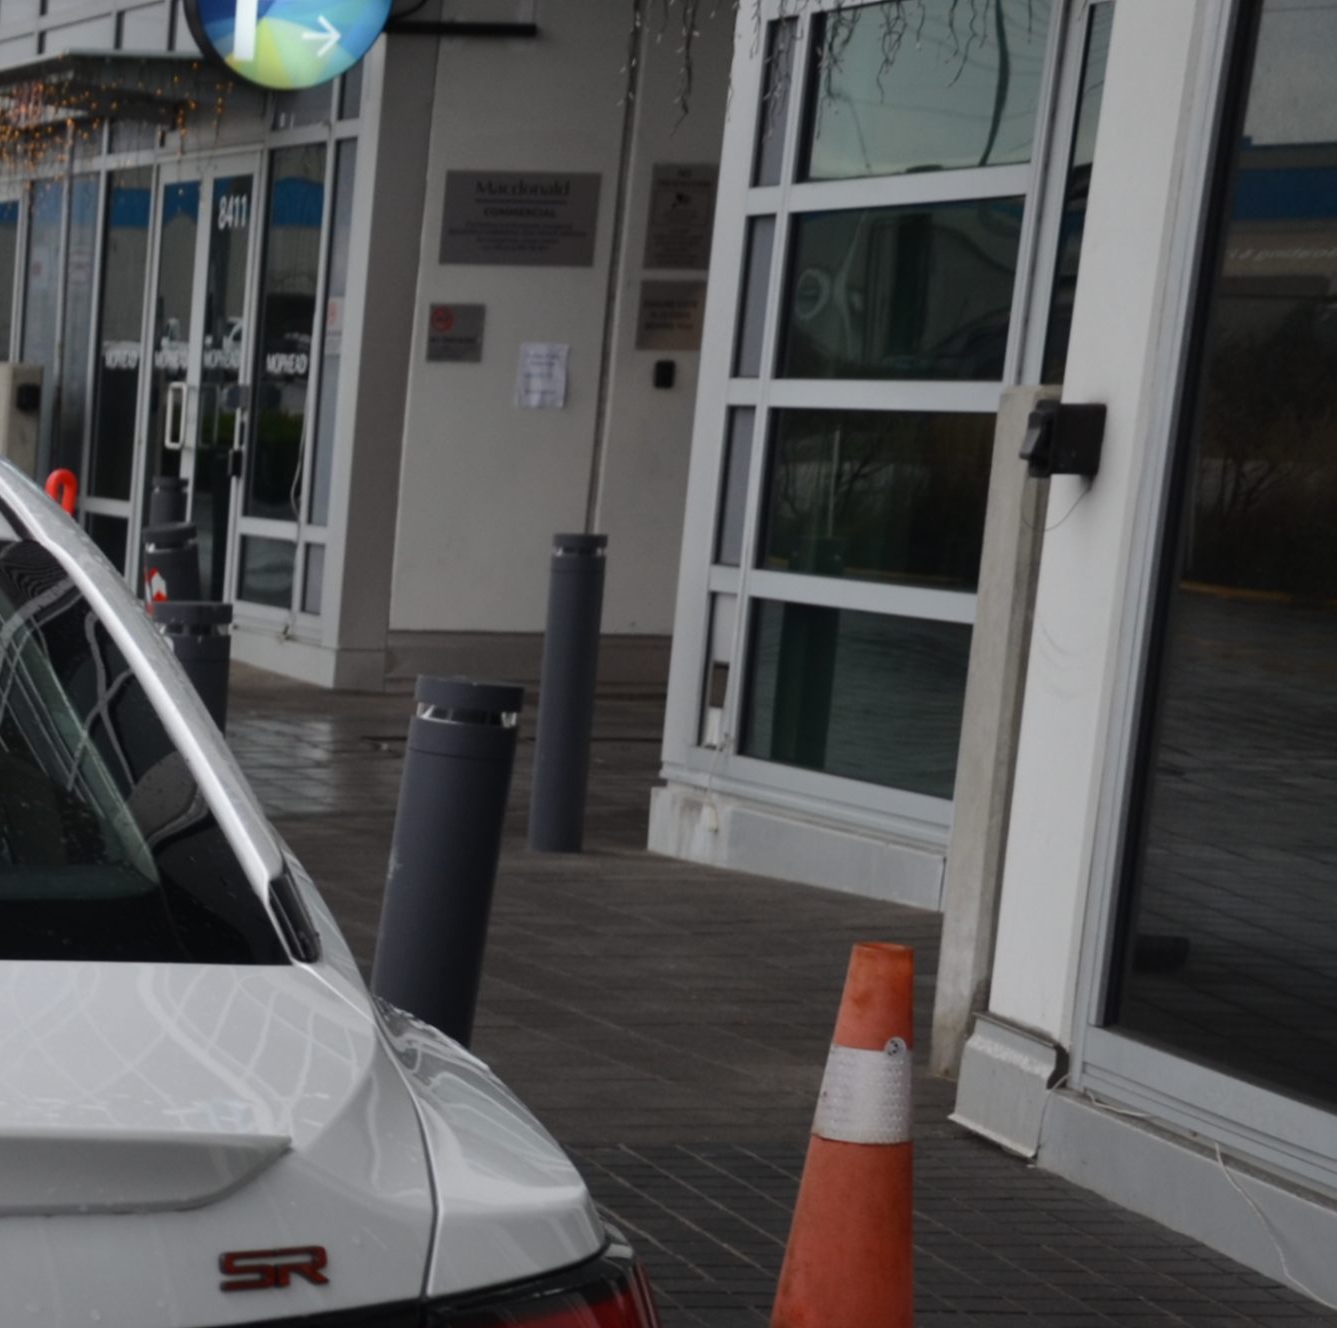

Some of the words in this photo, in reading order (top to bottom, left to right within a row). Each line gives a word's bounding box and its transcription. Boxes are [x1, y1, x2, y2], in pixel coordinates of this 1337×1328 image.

[476, 179, 571, 197] Macdonald
[218, 194, 247, 230] 8411
[218, 1244, 331, 1293] SR
